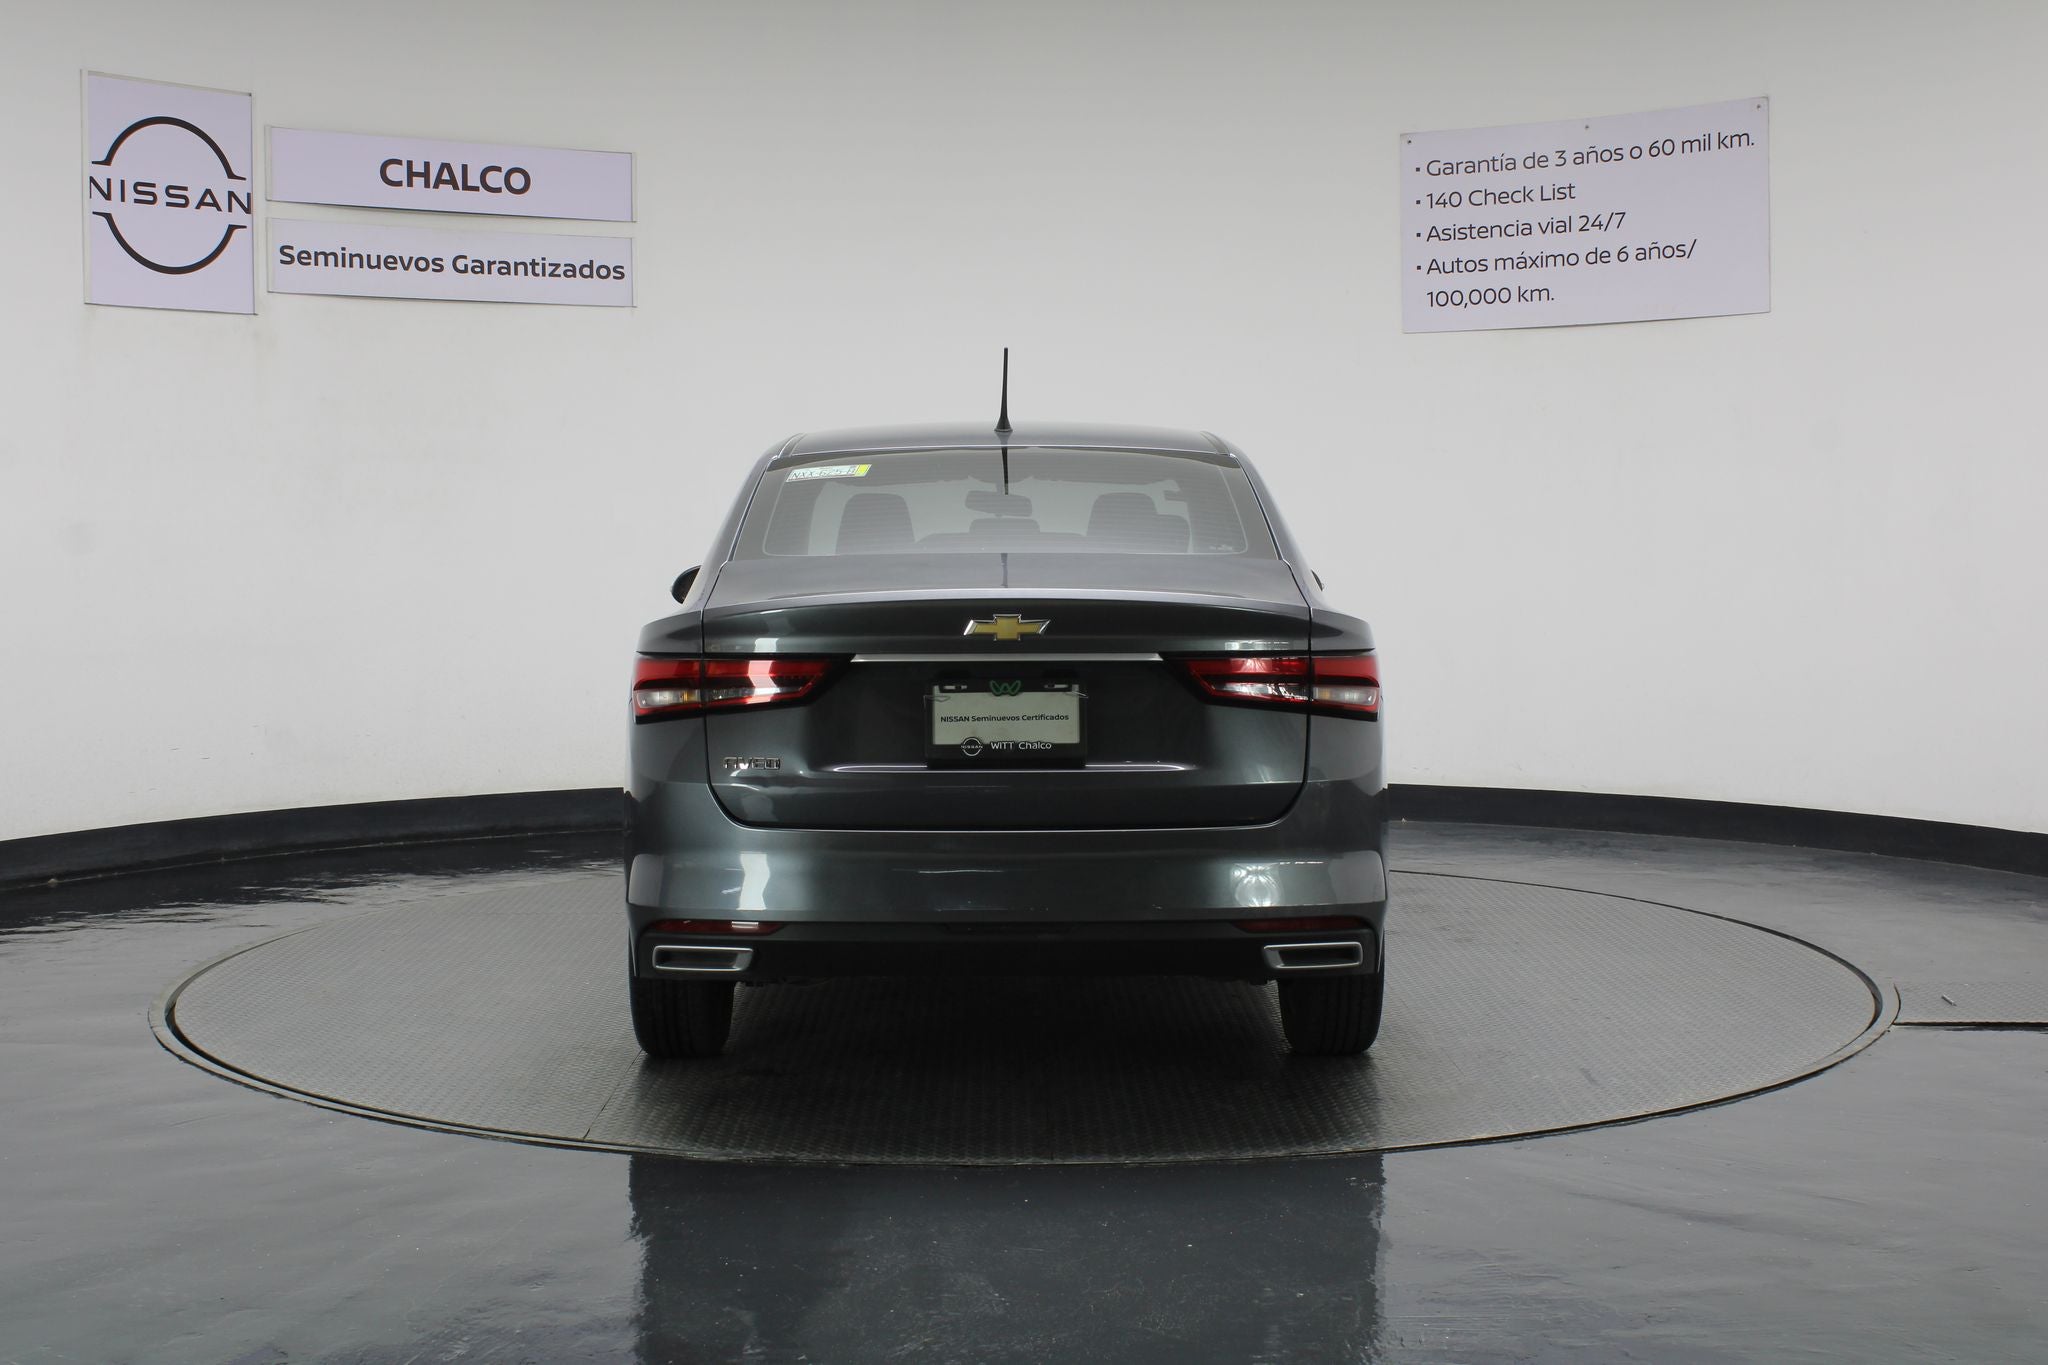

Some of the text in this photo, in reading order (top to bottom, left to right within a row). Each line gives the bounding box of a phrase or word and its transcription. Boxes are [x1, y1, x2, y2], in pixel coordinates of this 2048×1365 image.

[1426, 131, 1755, 177] Garantía de 3 años o 60 mil km.
[379, 158, 532, 196] CHALCO
[89, 175, 252, 215] NISSAN
[1426, 182, 1577, 210] 140 Check List
[1426, 211, 1627, 243] Asistencia vial 24/7
[279, 244, 626, 281] Seminuevos Garantizados
[1426, 238, 1698, 275] Autos máximo de 6 años/
[1426, 285, 1555, 309] 100,000 km.
[940, 713, 1070, 723] NISSAN Seminuevos Certificados
[990, 741, 1052, 750] WITT Chalco
